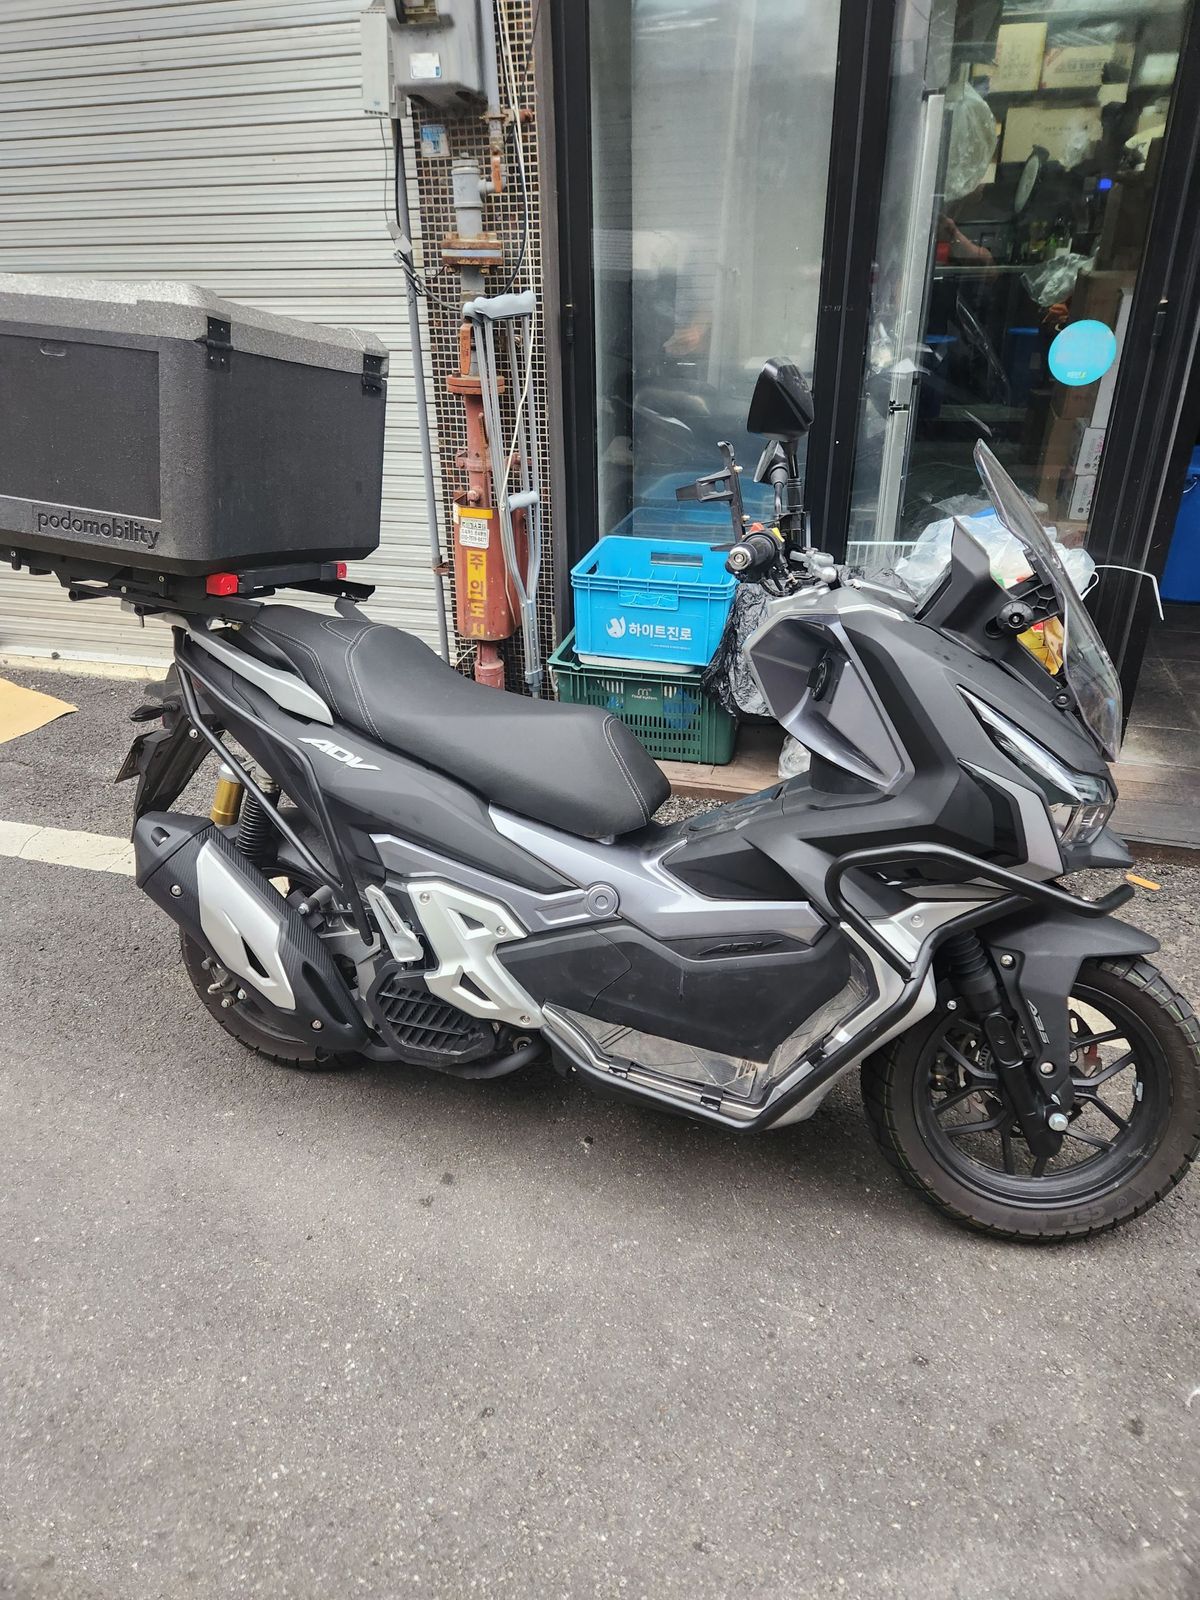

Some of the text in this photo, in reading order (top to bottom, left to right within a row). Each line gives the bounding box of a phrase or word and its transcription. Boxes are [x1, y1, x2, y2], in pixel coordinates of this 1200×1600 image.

[38, 511, 160, 549] podomobility
[628, 622, 693, 641] 하이트진로
[297, 737, 382, 771] ADV
